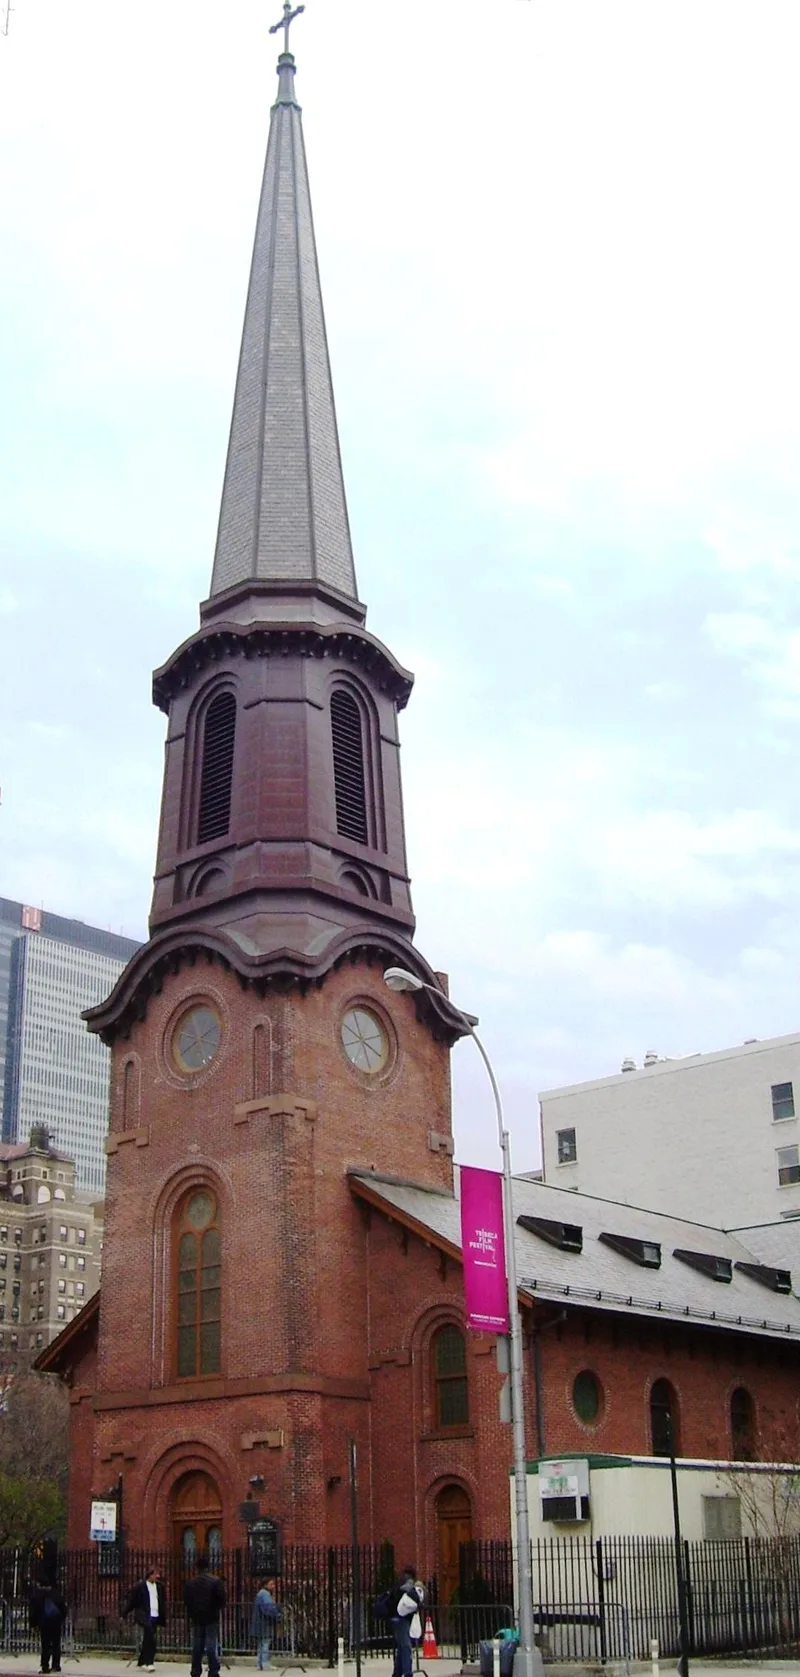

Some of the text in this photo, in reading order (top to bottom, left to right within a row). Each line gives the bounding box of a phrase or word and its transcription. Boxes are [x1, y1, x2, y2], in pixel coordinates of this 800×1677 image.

[475, 1229, 498, 1239] TRIBECA
[479, 1236, 492, 1244] FILM
[469, 1241, 496, 1252] FESTIVAL
